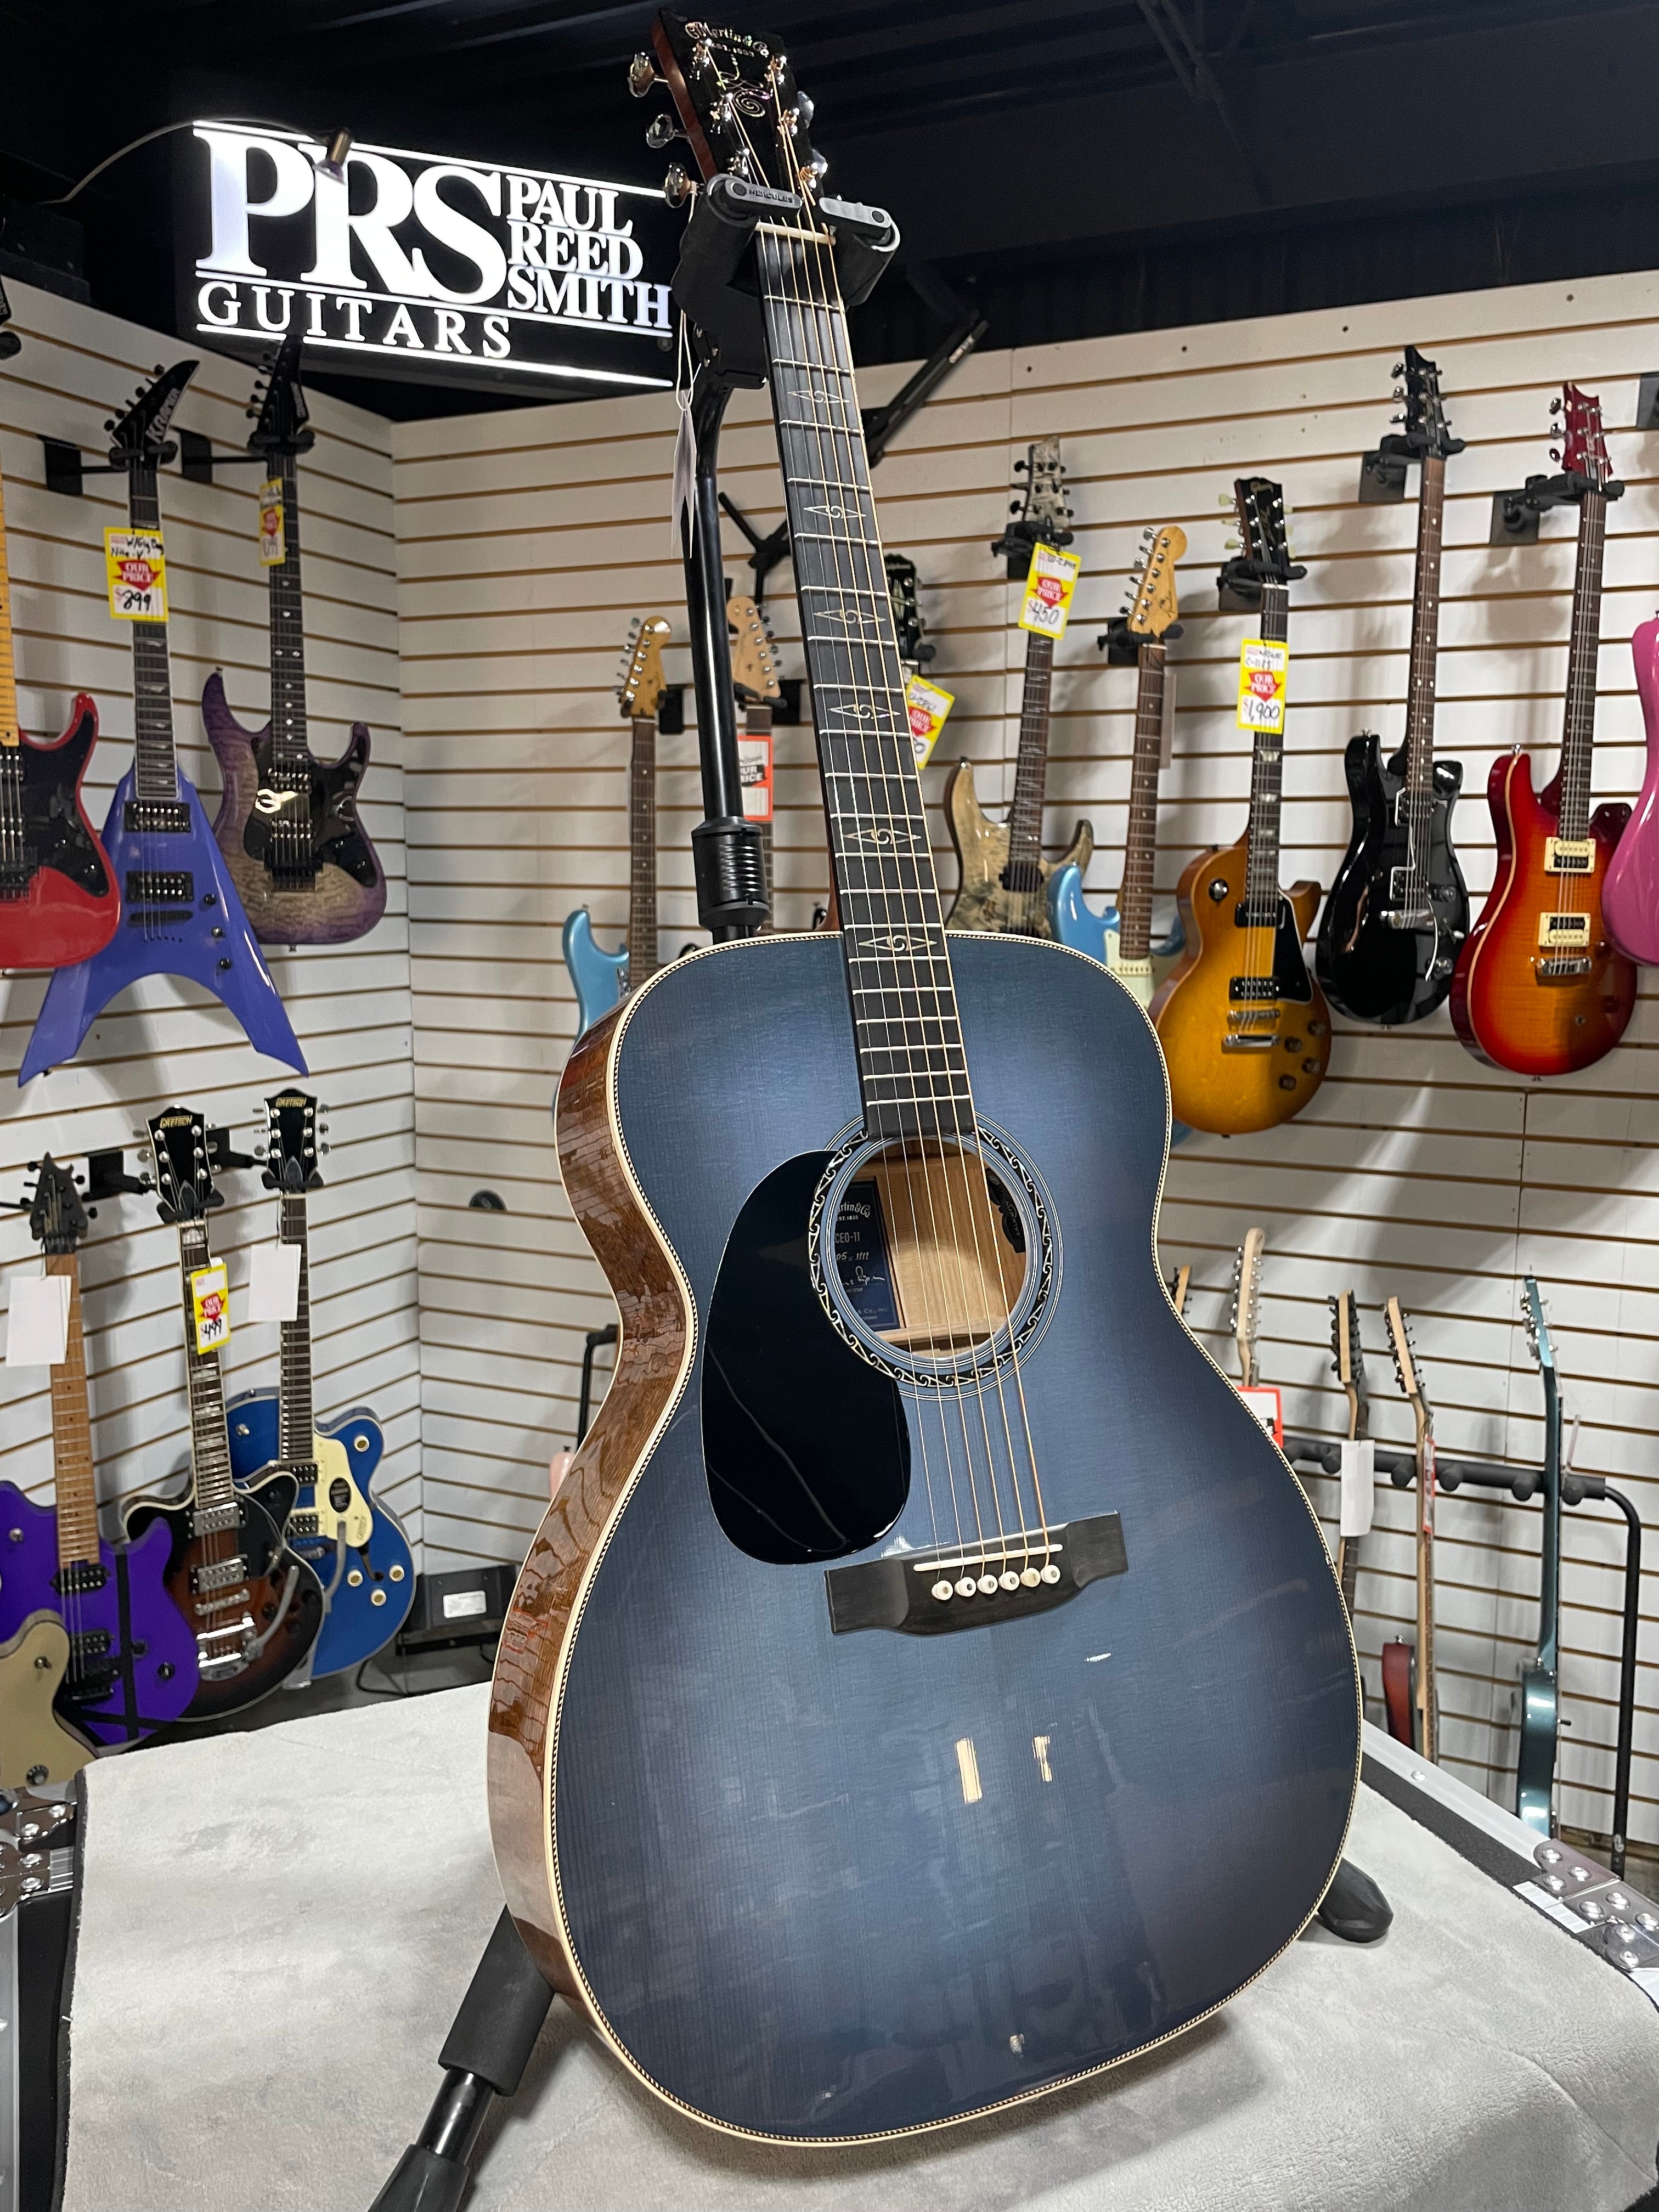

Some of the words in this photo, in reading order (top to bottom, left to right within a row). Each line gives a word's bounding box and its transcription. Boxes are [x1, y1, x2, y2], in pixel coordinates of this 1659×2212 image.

[749, 189, 793, 204] HERCULES
[506, 174, 632, 236] PAUL
[193, 129, 507, 304] PRS
[506, 219, 643, 280] REED
[507, 266, 673, 329] SMITH
[197, 280, 511, 358] GUITARS
[125, 563, 149, 573] OUR
[122, 572, 154, 583] PRICE
[1042, 579, 1062, 591] OUR
[1037, 586, 1063, 602] PRICE
[1254, 673, 1274, 684] OUR
[1251, 682, 1277, 695] PRICE
[911, 709, 932, 725] OUR
[741, 766, 758, 775] UR
[276, 1097, 307, 1108] GRETSCH
[160, 1115, 193, 1128] GRETSCH
[205, 1295, 220, 1307] OUR
[204, 1303, 222, 1318] PRICE
